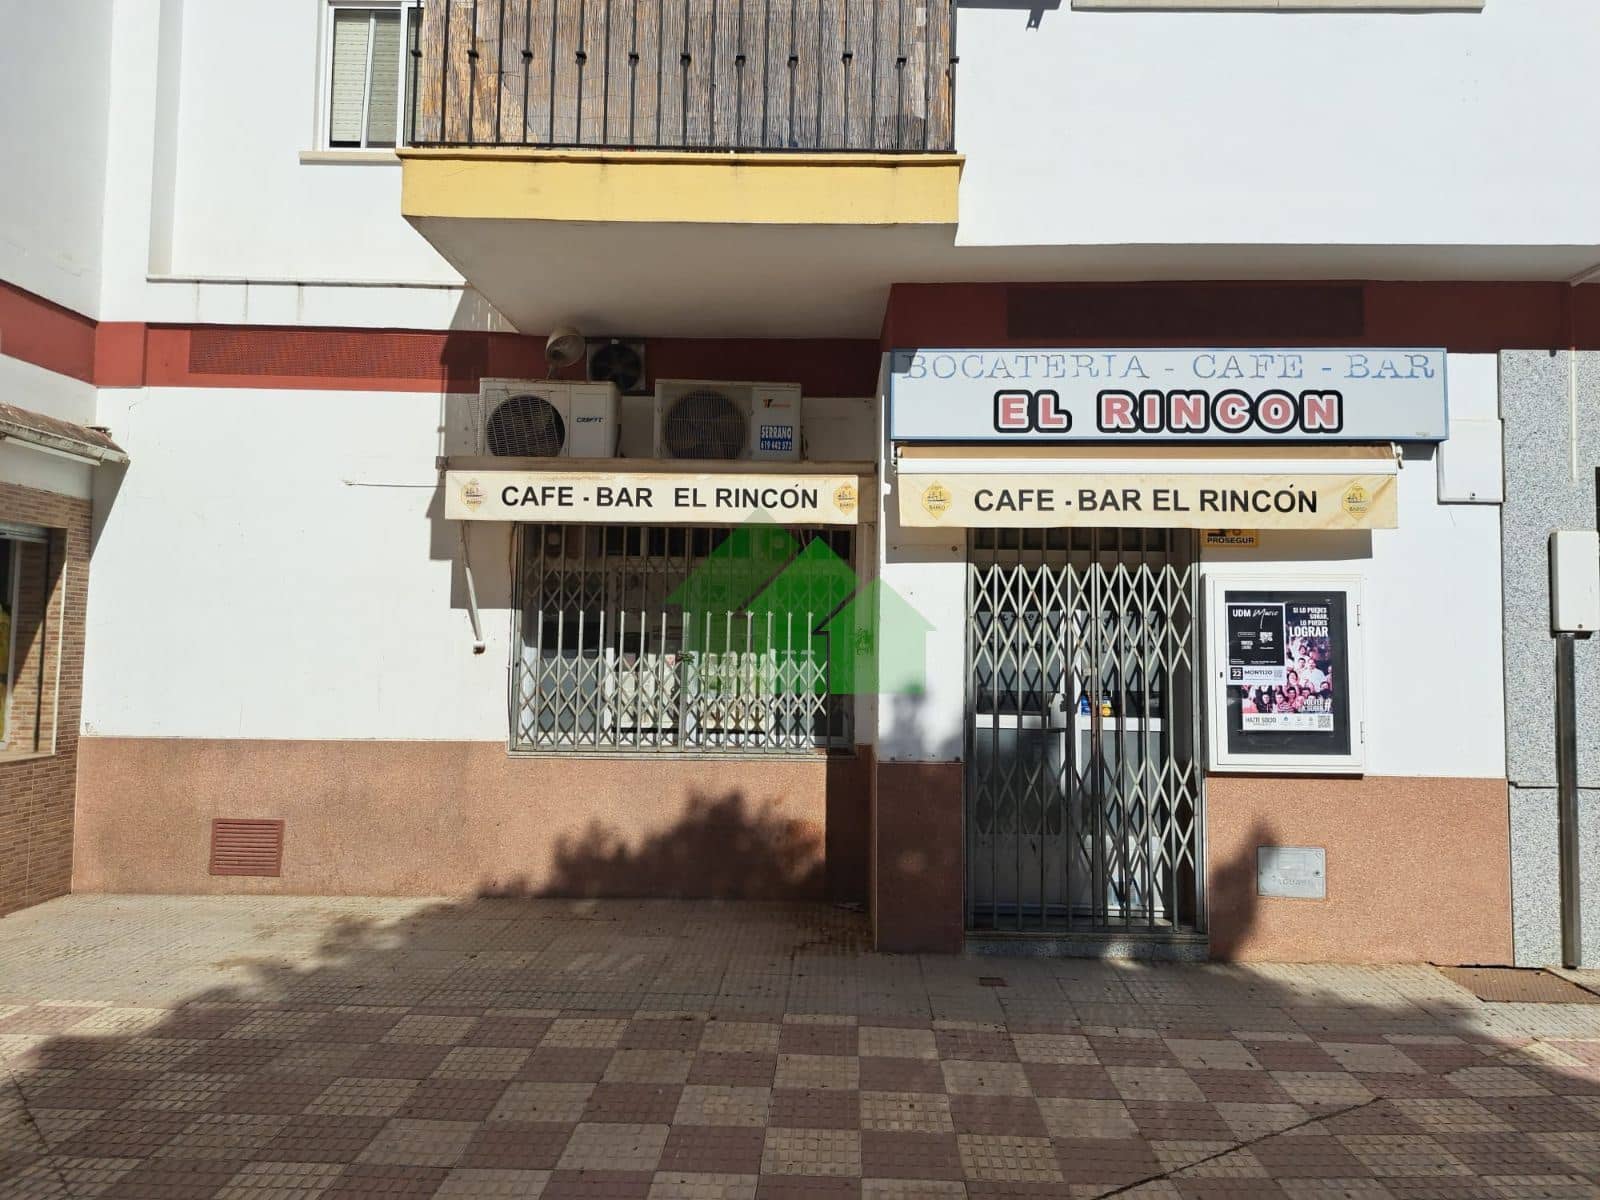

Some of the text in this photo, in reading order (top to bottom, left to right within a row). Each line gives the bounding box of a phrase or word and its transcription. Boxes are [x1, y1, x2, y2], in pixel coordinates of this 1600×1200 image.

[903, 353, 1151, 380] BOCATERIA
[1192, 353, 1304, 379] CAFE
[1343, 353, 1435, 380] BAR
[995, 390, 1343, 432] EL RINCON
[761, 426, 792, 439] SERRANO
[501, 486, 574, 507] CAFE
[595, 486, 653, 508] BAR
[674, 487, 706, 508] EL
[715, 483, 818, 509] RINCÓN
[974, 489, 1054, 512] CAFE
[1078, 489, 1141, 511] BAR
[1153, 489, 1190, 511] EL
[1199, 483, 1317, 513] RINCÓN
[1207, 536, 1254, 544] PROSEGUR
[1232, 608, 1251, 617] UDM
[1289, 626, 1329, 637] LOGRAR
